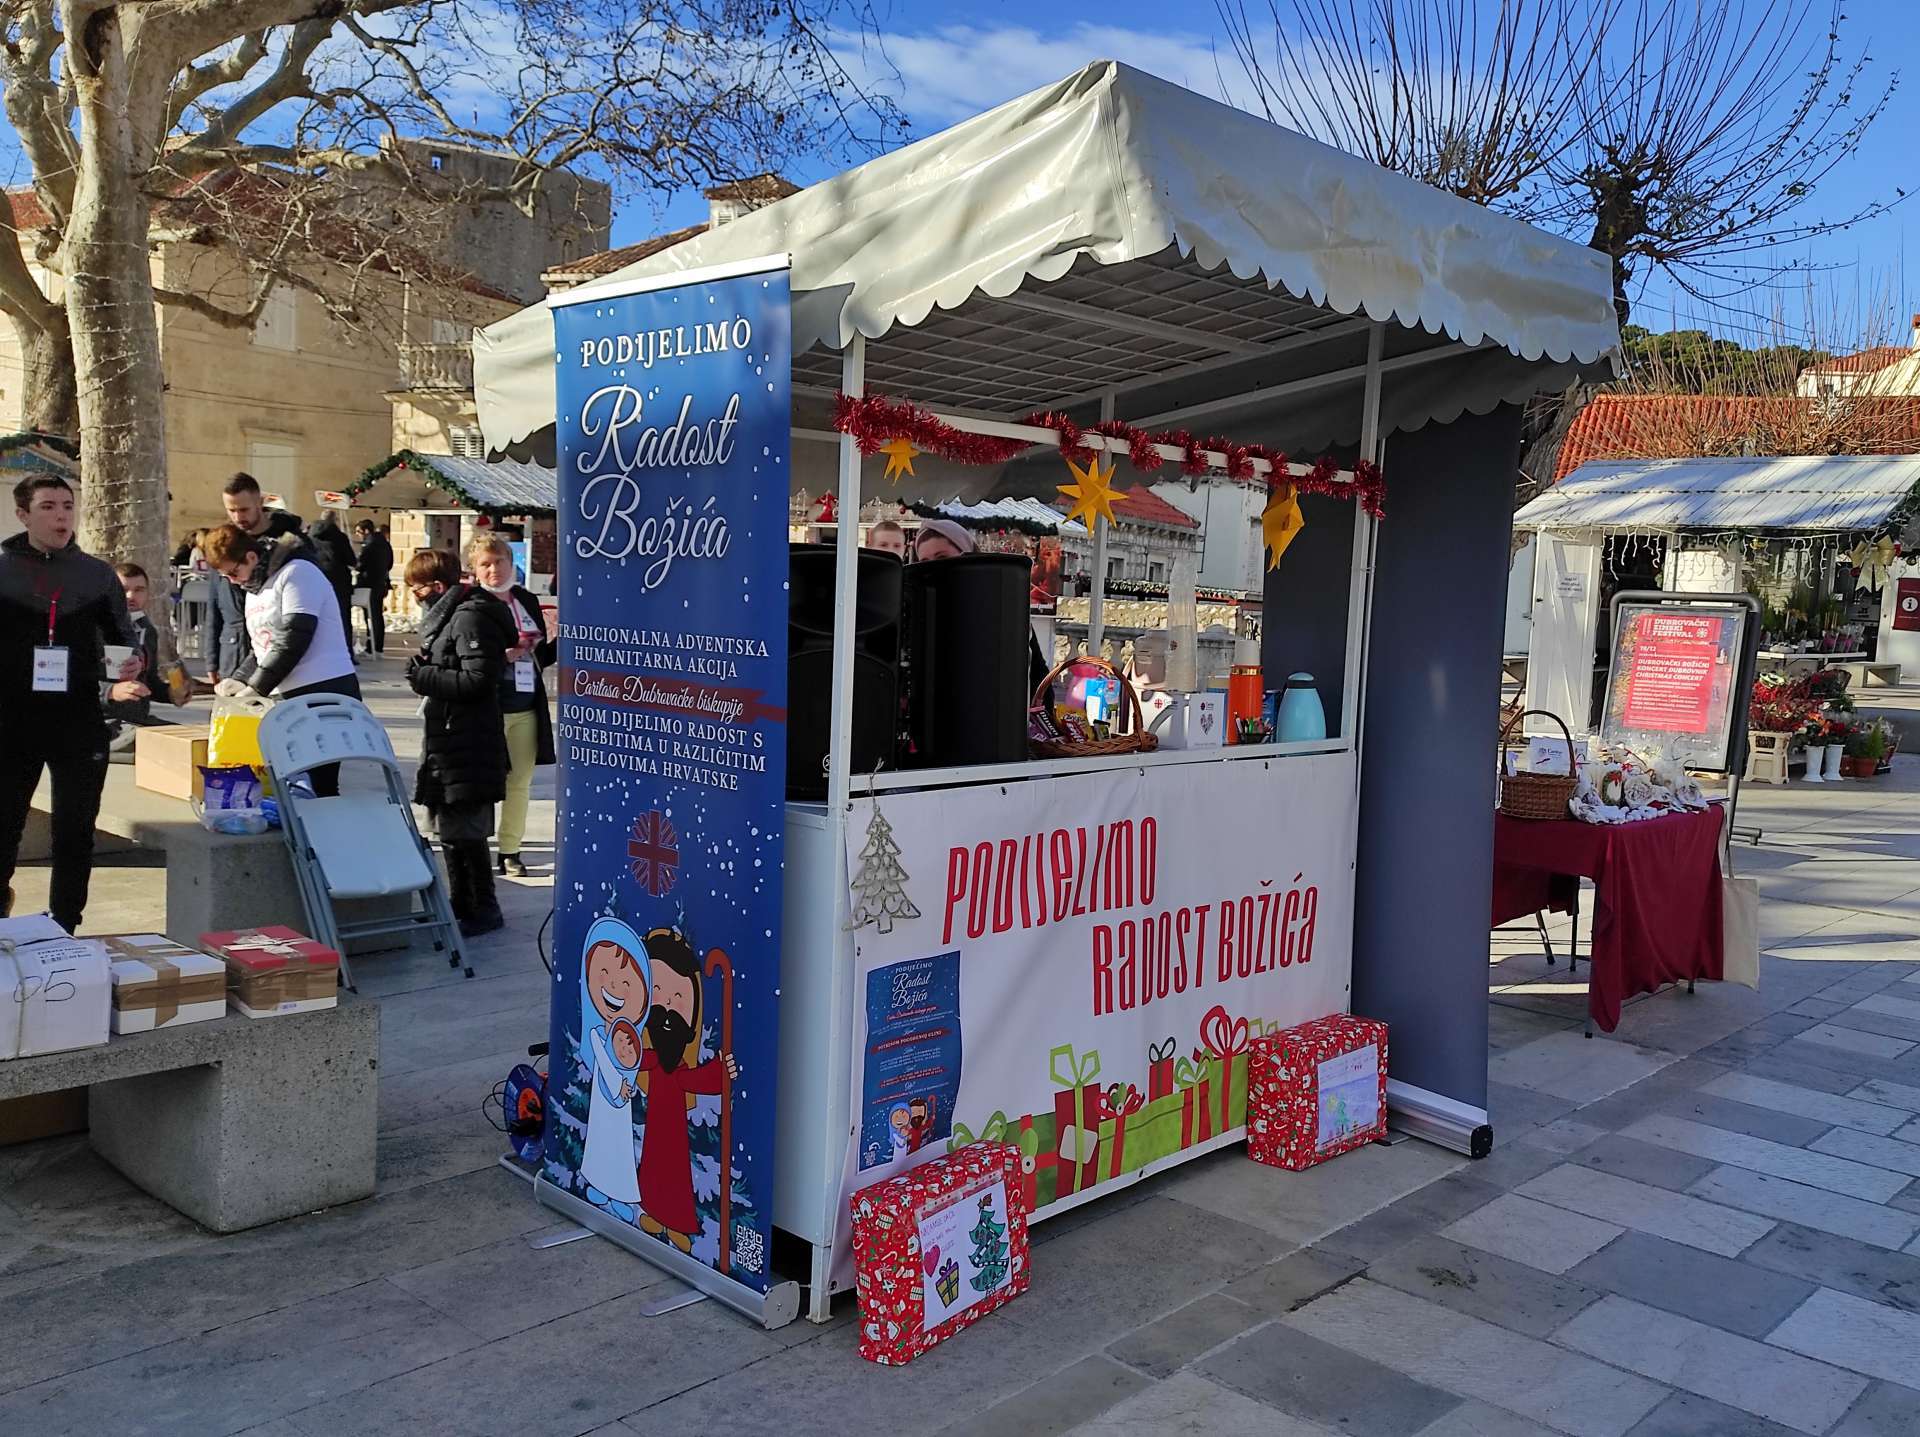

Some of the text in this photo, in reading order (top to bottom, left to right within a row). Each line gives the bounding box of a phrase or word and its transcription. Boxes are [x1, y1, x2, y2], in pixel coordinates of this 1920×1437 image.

[581, 317, 751, 369] PODIJELIMO
[577, 384, 740, 474] Radost
[576, 472, 732, 589] Božića
[559, 622, 769, 657] TRADICIONALNA ADVENTSKA
[1652, 630, 1693, 638] FESTIVAL
[575, 645, 738, 681] HUMANITARNA AKCIJA
[574, 668, 620, 697] Caritasa
[622, 675, 695, 709] Dubrovačke
[697, 688, 744, 725] biskupije
[559, 723, 766, 773] POTREBITIMA U RAZLIČITIM
[563, 703, 764, 749] KOJOM DIJELIMO RADOST S
[571, 745, 738, 791] DIJELOVIMA HRVATSKE
